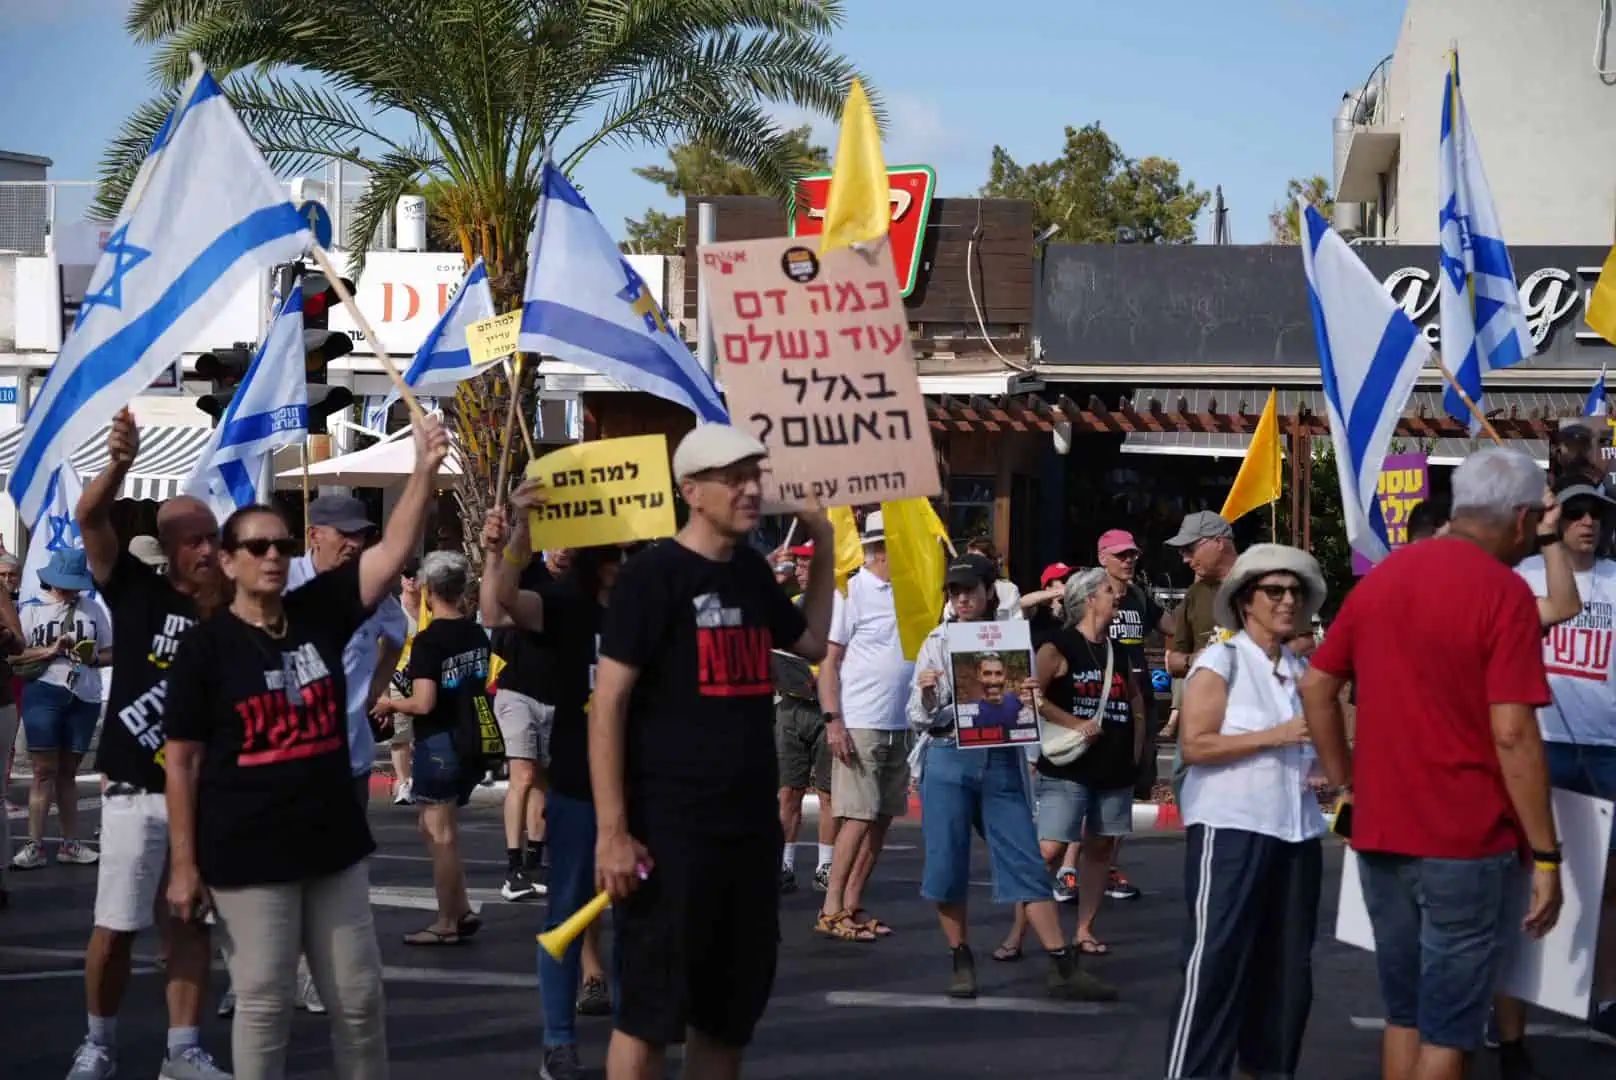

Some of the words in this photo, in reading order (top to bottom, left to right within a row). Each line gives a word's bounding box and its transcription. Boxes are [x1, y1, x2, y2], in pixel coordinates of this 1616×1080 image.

[733, 289, 788, 320] דם
[806, 280, 890, 316] כמה
[722, 324, 830, 365] נשלם
[838, 324, 904, 356] עוד
[782, 368, 897, 404] בגלל
[750, 410, 912, 447] האשם?
[552, 468, 585, 488] הם
[590, 461, 638, 484] למה
[848, 471, 906, 494] הדחה
[609, 492, 665, 516] עדיין
[696, 627, 773, 683] NOW
[1545, 628, 1613, 669] עכשי
